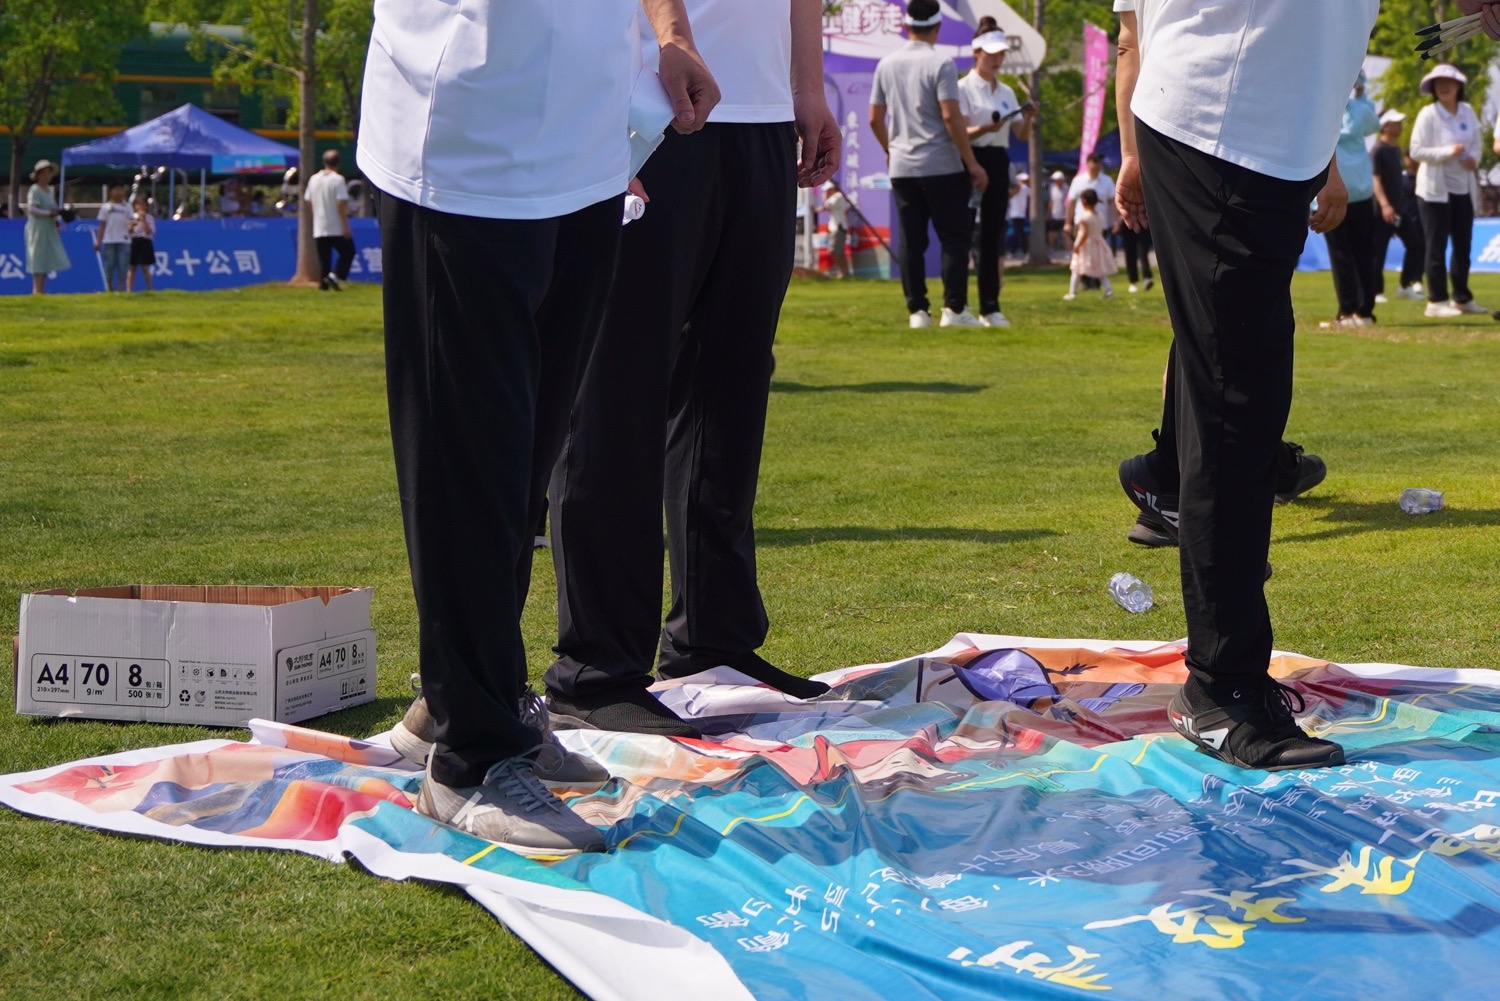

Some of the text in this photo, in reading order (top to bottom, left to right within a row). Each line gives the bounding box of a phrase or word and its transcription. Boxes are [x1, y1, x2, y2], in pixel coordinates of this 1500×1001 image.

[318, 652, 332, 668] A4
[335, 647, 346, 663] 70
[352, 644, 357, 658] 8
[37, 662, 142, 687] A4 70 8
[128, 690, 143, 698] 500
[1171, 711, 1229, 750] FILA
